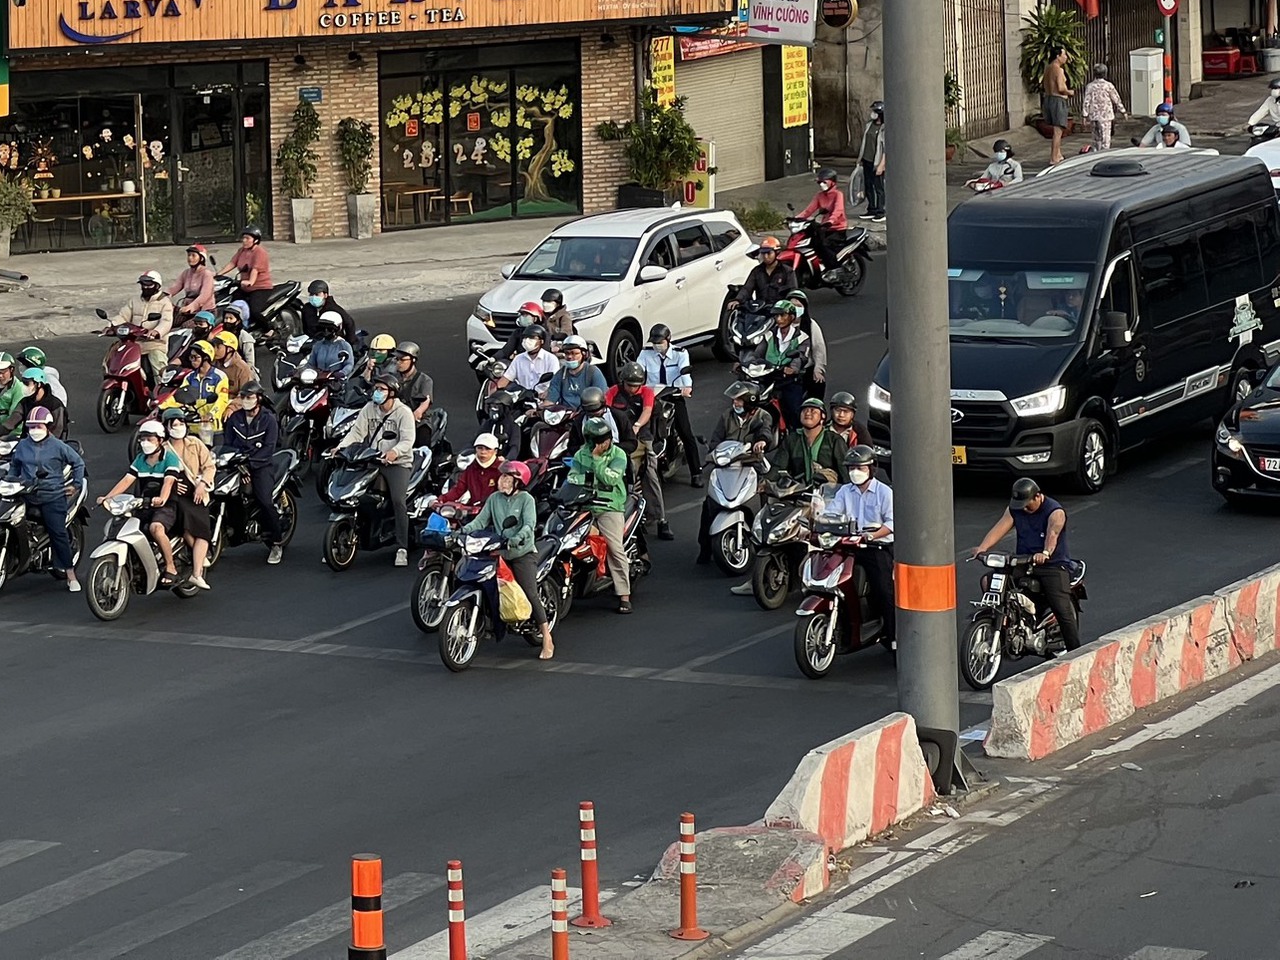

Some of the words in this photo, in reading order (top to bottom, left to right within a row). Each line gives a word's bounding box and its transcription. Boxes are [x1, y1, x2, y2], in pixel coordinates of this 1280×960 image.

[319, 10, 402, 29] COFFEE
[426, 7, 467, 24] TEA
[752, 2, 774, 21] VĨNH
[775, 5, 810, 24] CƯỜNG
[653, 38, 670, 53] 277
